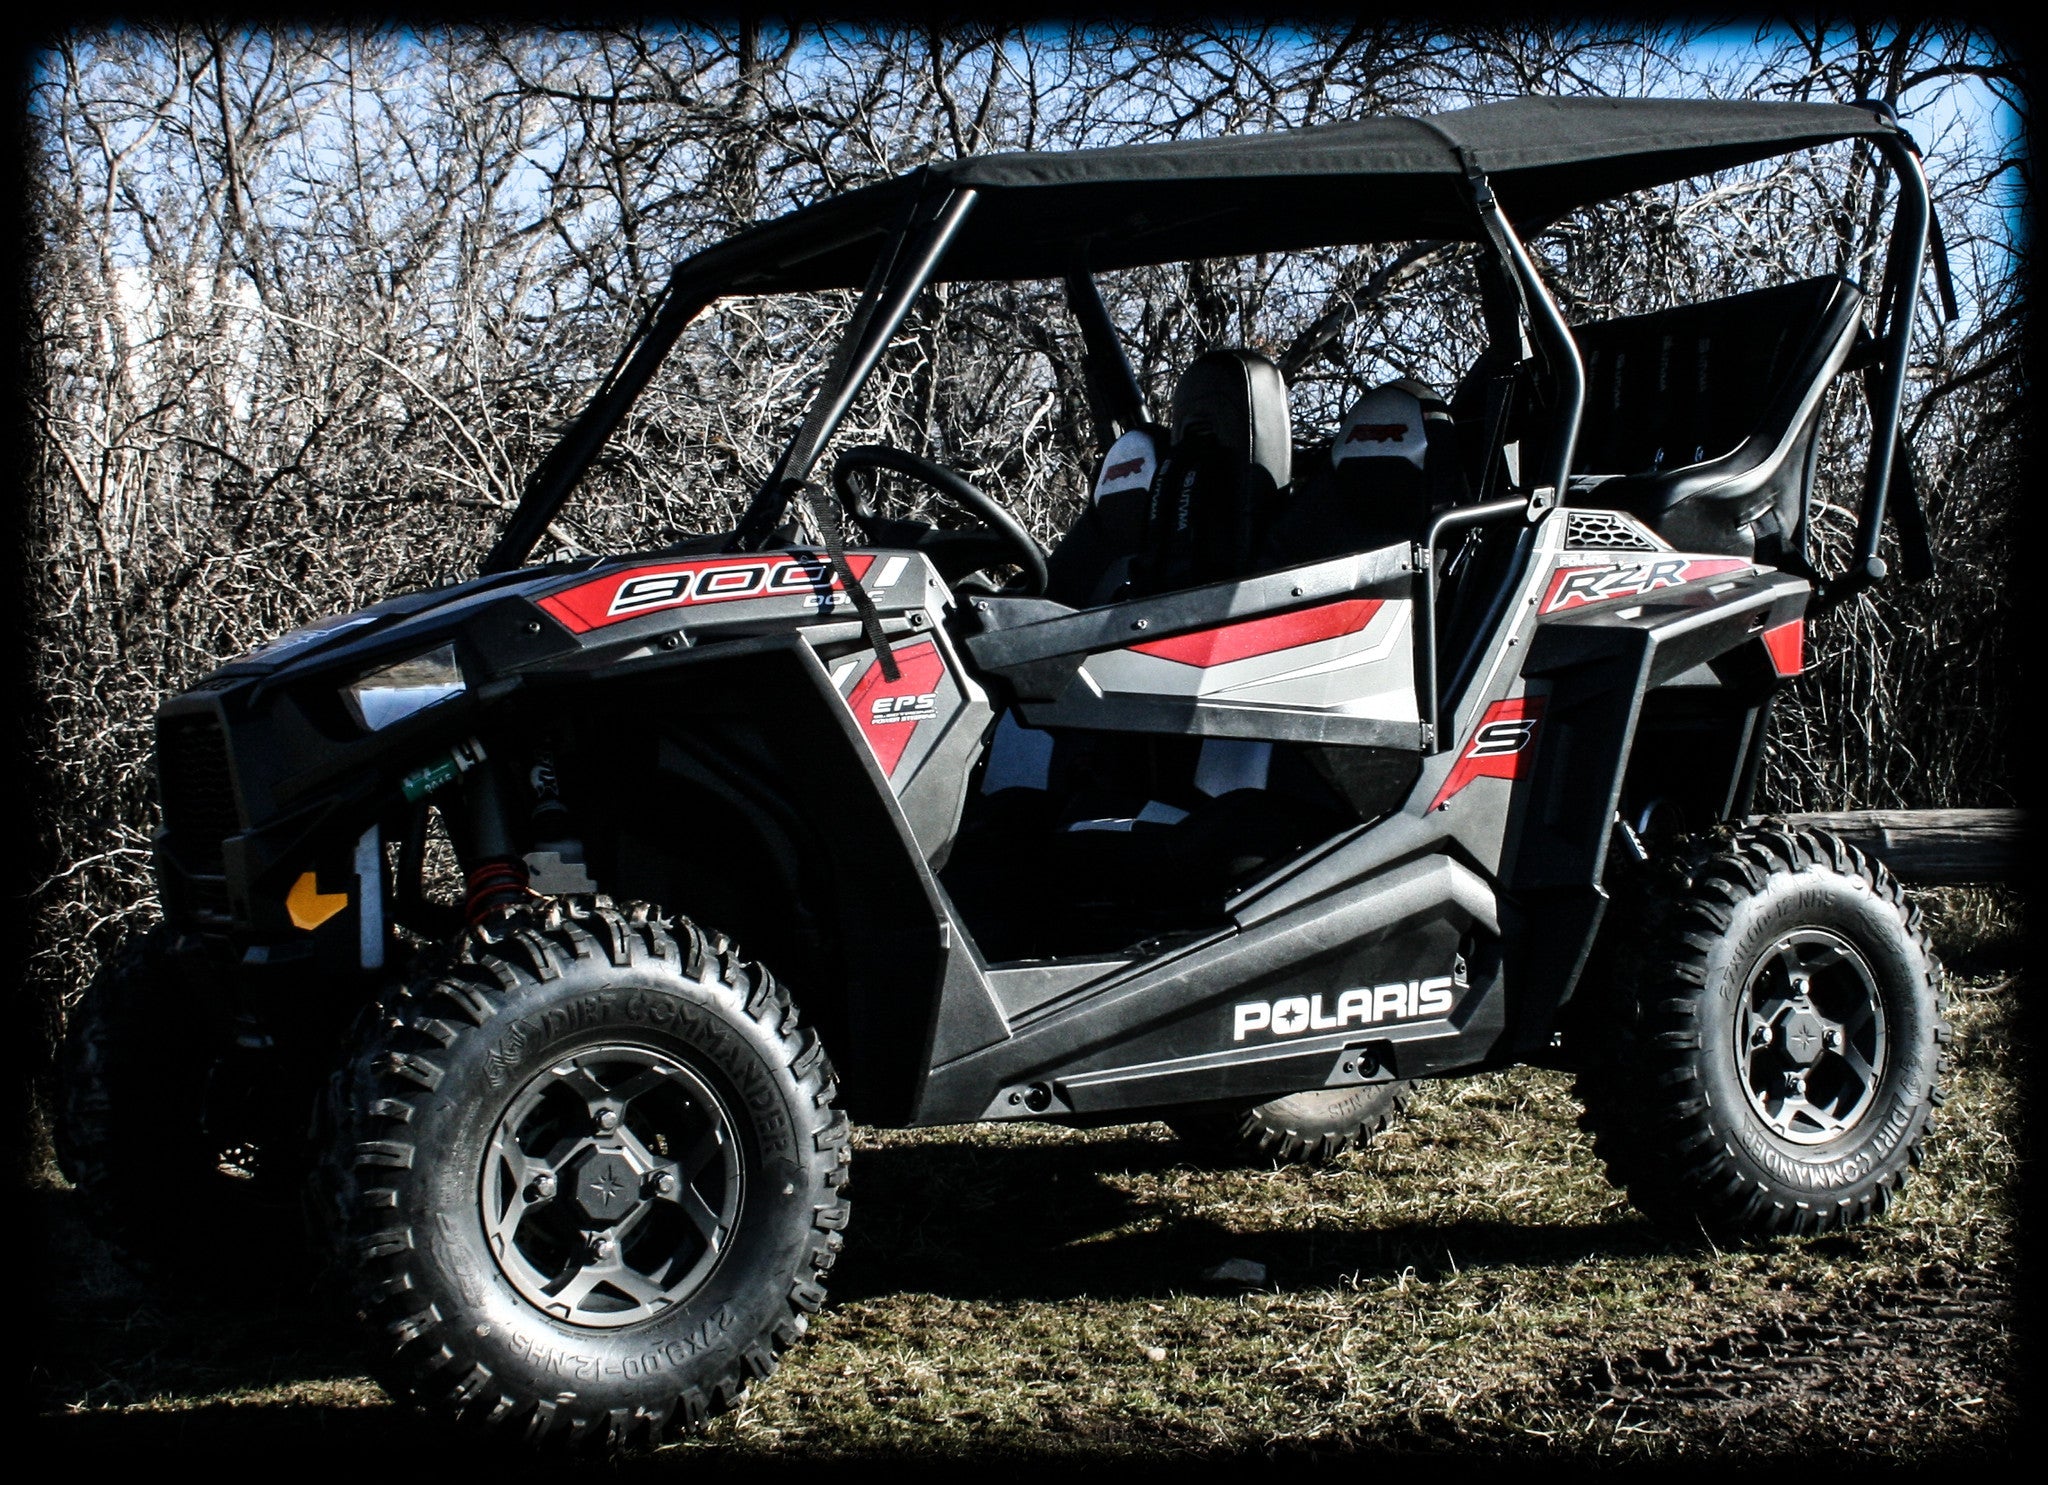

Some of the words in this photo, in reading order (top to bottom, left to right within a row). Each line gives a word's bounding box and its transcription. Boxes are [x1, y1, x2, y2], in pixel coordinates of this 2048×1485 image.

[606, 560, 838, 617] 900
[803, 590, 885, 608] DOC
[1546, 559, 1691, 613] RZR
[871, 692, 937, 714] EPS
[1465, 719, 1538, 759] S
[1233, 976, 1453, 1041] POLARIS
[541, 992, 617, 1039] DIRT
[625, 993, 790, 1156] COMMANDER
[1743, 1130, 1874, 1189] COMMANDER
[1872, 1103, 1911, 1160] DIRT
